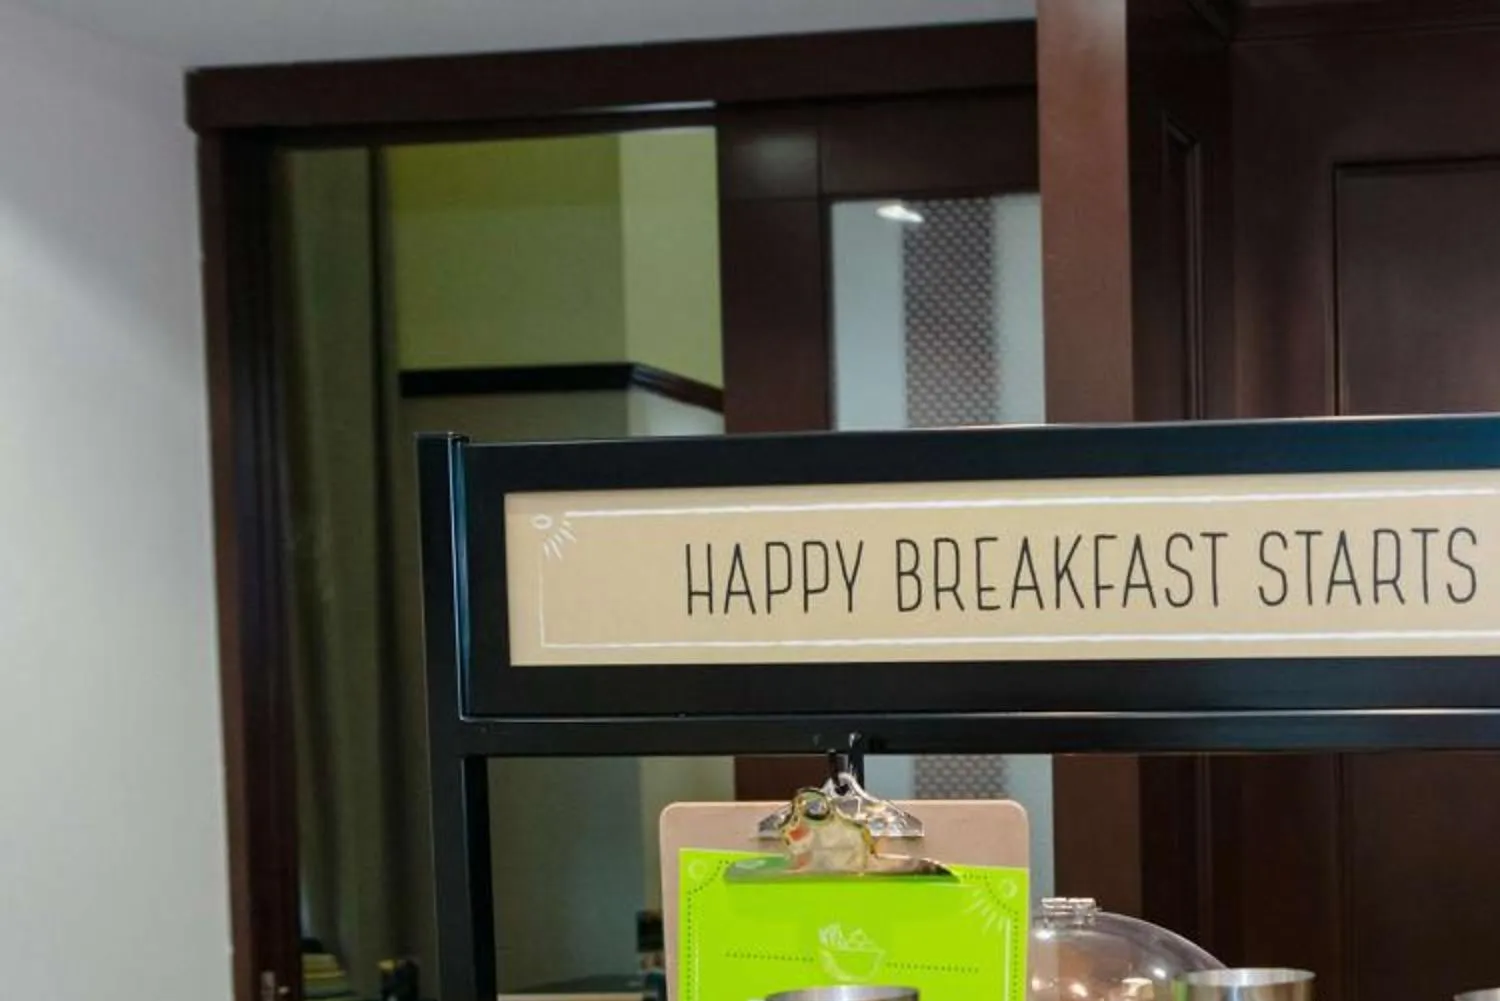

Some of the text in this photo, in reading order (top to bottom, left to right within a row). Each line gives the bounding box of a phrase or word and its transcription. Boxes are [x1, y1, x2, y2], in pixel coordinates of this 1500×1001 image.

[685, 539, 864, 616] HAPPY
[895, 532, 1229, 613] BREAKFAST
[1258, 527, 1478, 607] STARTS
